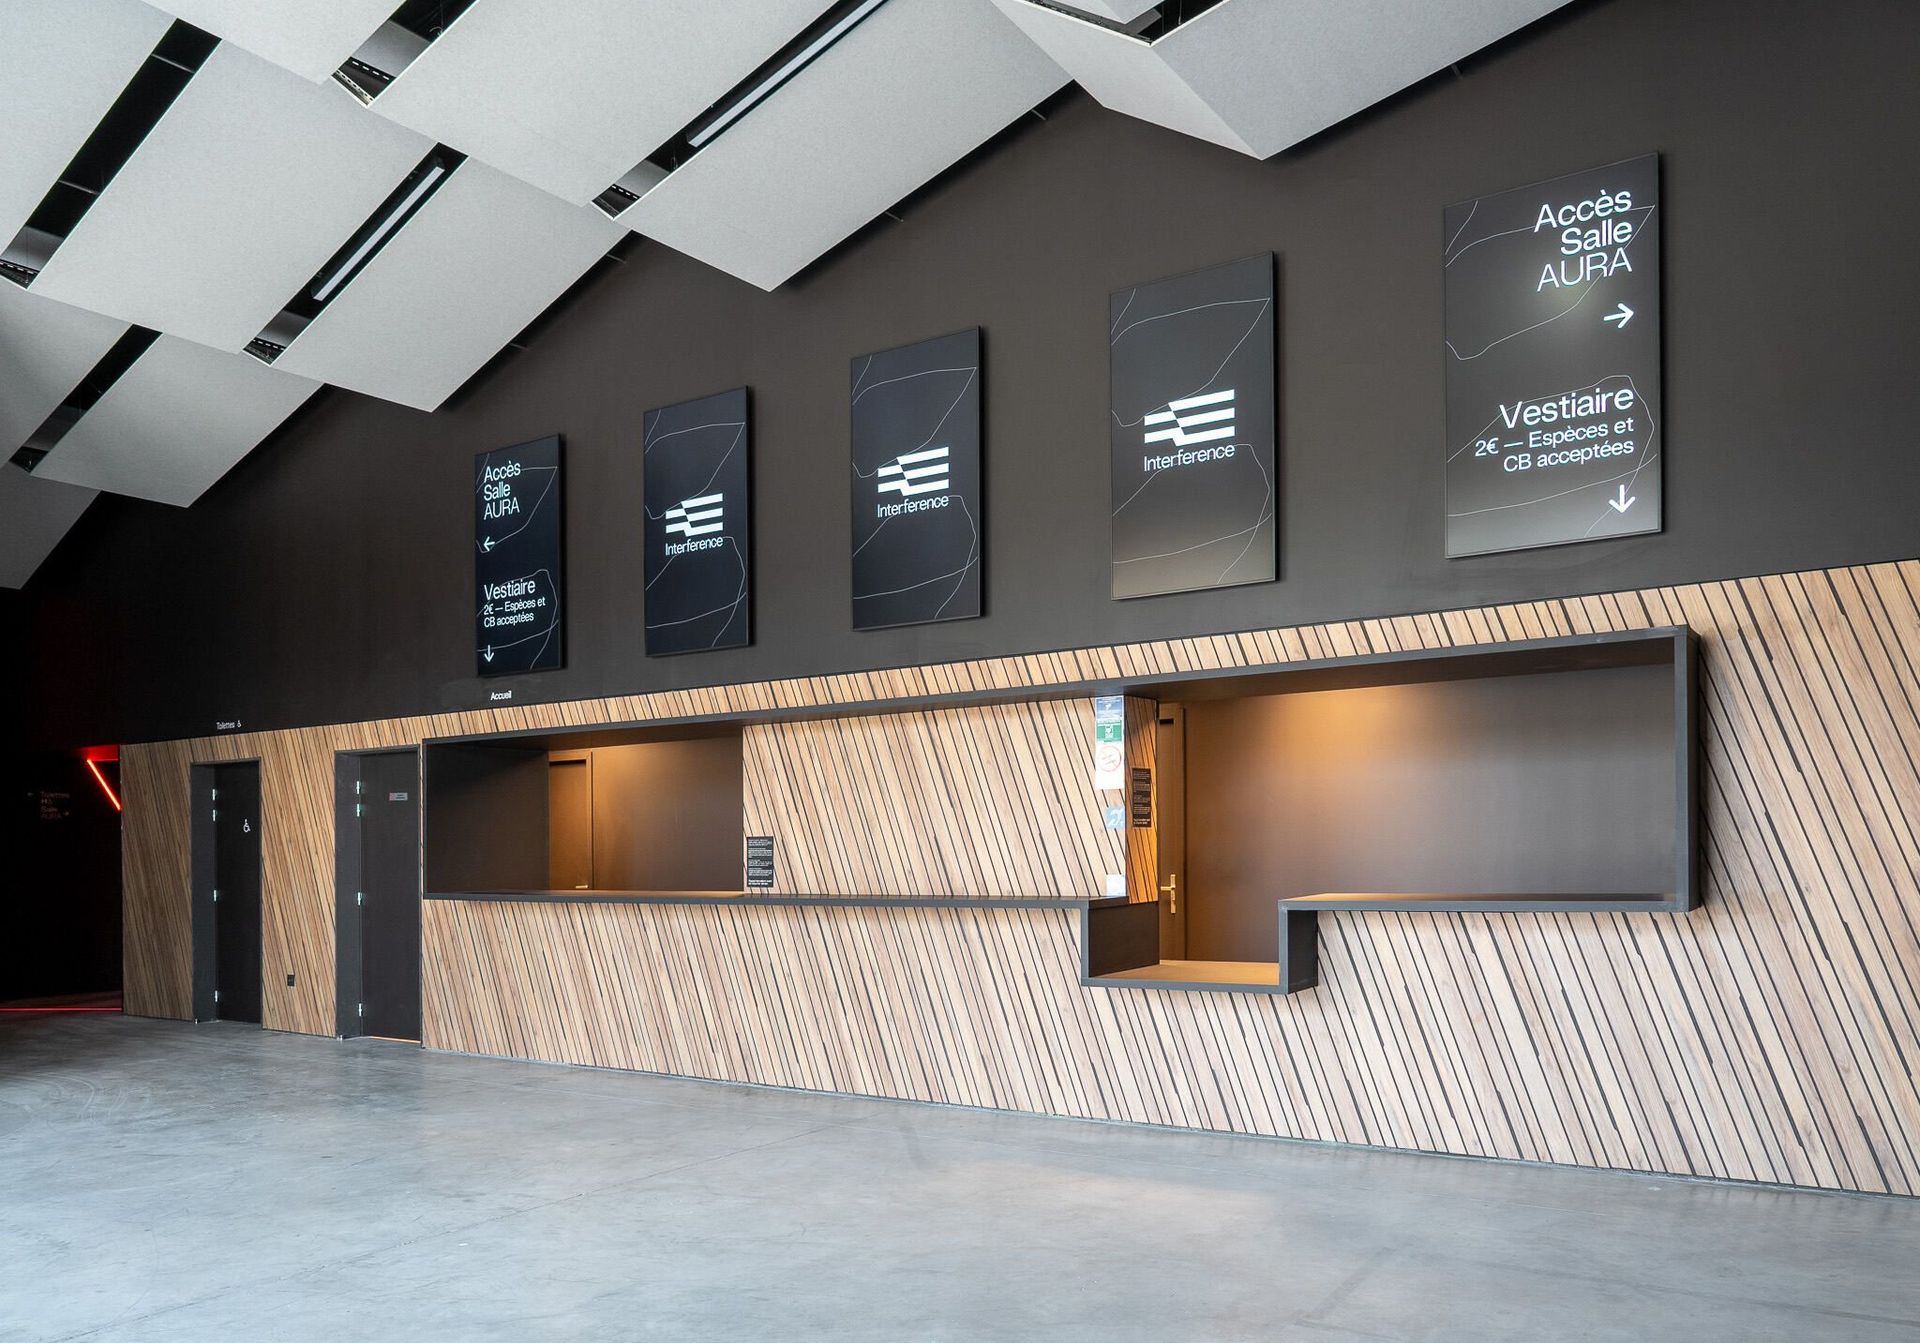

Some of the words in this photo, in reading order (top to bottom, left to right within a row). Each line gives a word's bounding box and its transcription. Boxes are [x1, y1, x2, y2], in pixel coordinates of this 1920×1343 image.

[1533, 189, 1632, 232] Accès
[1560, 218, 1633, 255] Salle
[1536, 247, 1633, 292] AURA
[1499, 387, 1634, 429] Vestiaire
[1475, 437, 1499, 457] 2€
[1528, 423, 1609, 451] Espèces
[1613, 417, 1634, 434] et
[1143, 444, 1236, 472] Interference
[1503, 452, 1532, 472] CB
[1536, 439, 1634, 466] acceptées
[483, 459, 521, 483] Accès
[483, 480, 511, 501] Salle
[483, 496, 520, 520] AURA
[876, 495, 950, 518] Interference
[665, 536, 724, 556] Interference
[483, 578, 536, 601] Vestiaire
[483, 603, 494, 615] 2€
[504, 598, 536, 614] Espèces
[537, 596, 546, 607] et
[483, 616, 496, 628] CB
[496, 611, 535, 627] acceptées
[490, 690, 512, 701] Accueil
